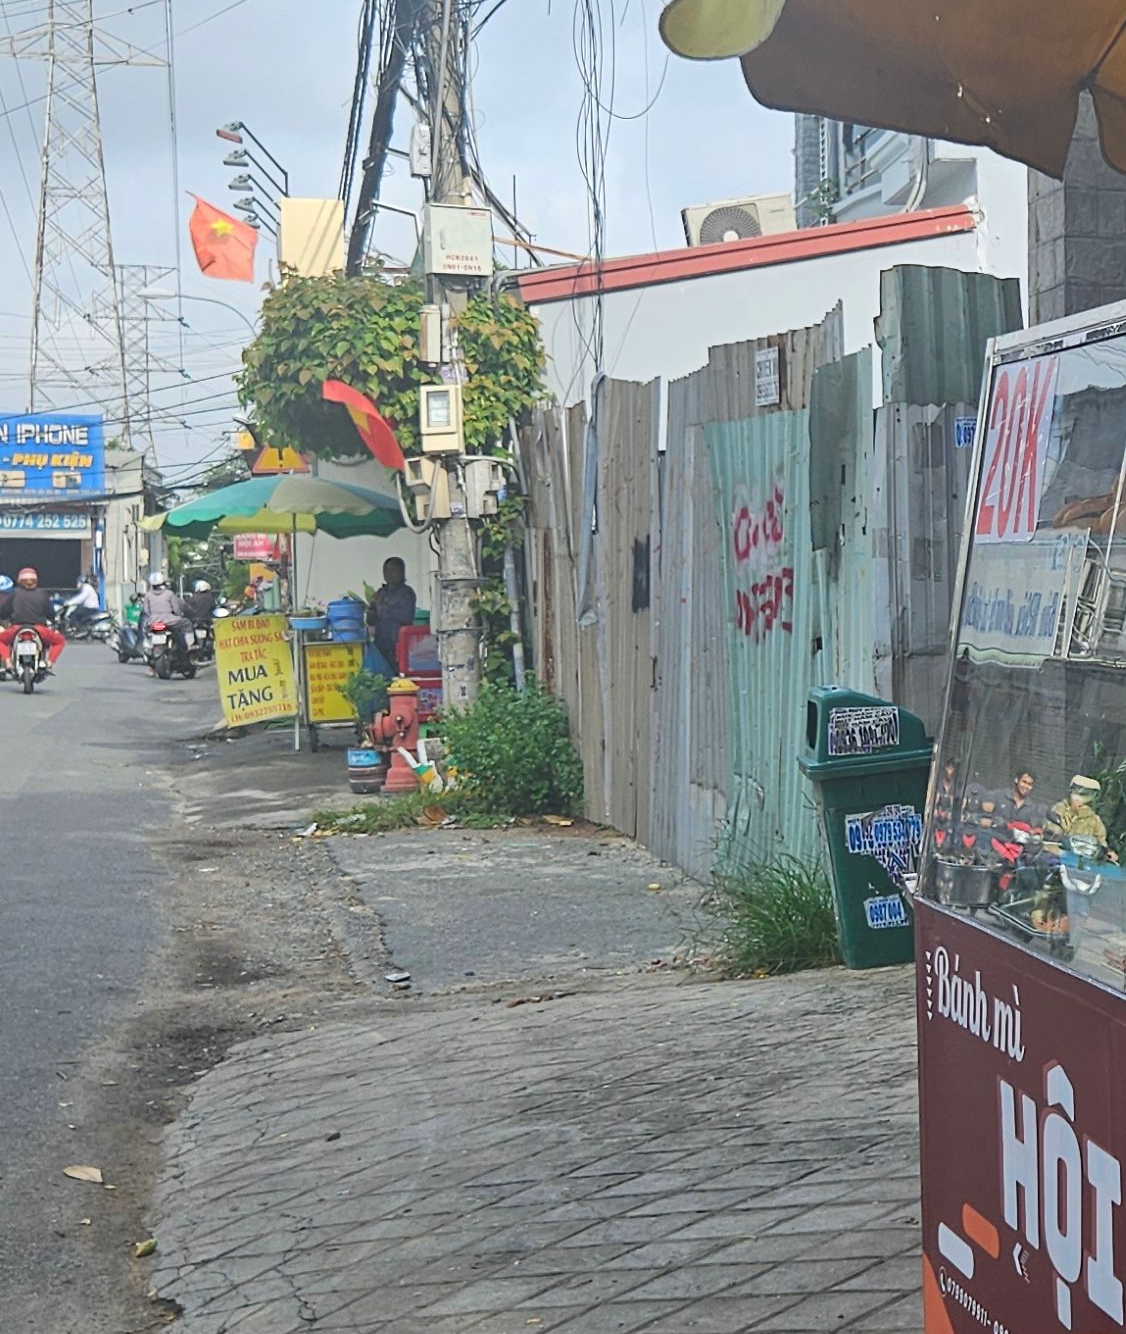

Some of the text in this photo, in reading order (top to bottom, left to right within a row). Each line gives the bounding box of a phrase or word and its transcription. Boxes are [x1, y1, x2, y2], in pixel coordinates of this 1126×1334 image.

[16, 423, 88, 445] IPHONE
[976, 355, 1057, 538] 20K
[12, 453, 49, 471] PHỤ
[50, 451, 93, 471] KIỆN
[3, 514, 87, 529] 0774 252 525
[227, 664, 268, 686] MUA
[226, 685, 274, 713] TẶNG
[934, 946, 1025, 1062] Bánh mì
[998, 1061, 1124, 1331] HỘI
